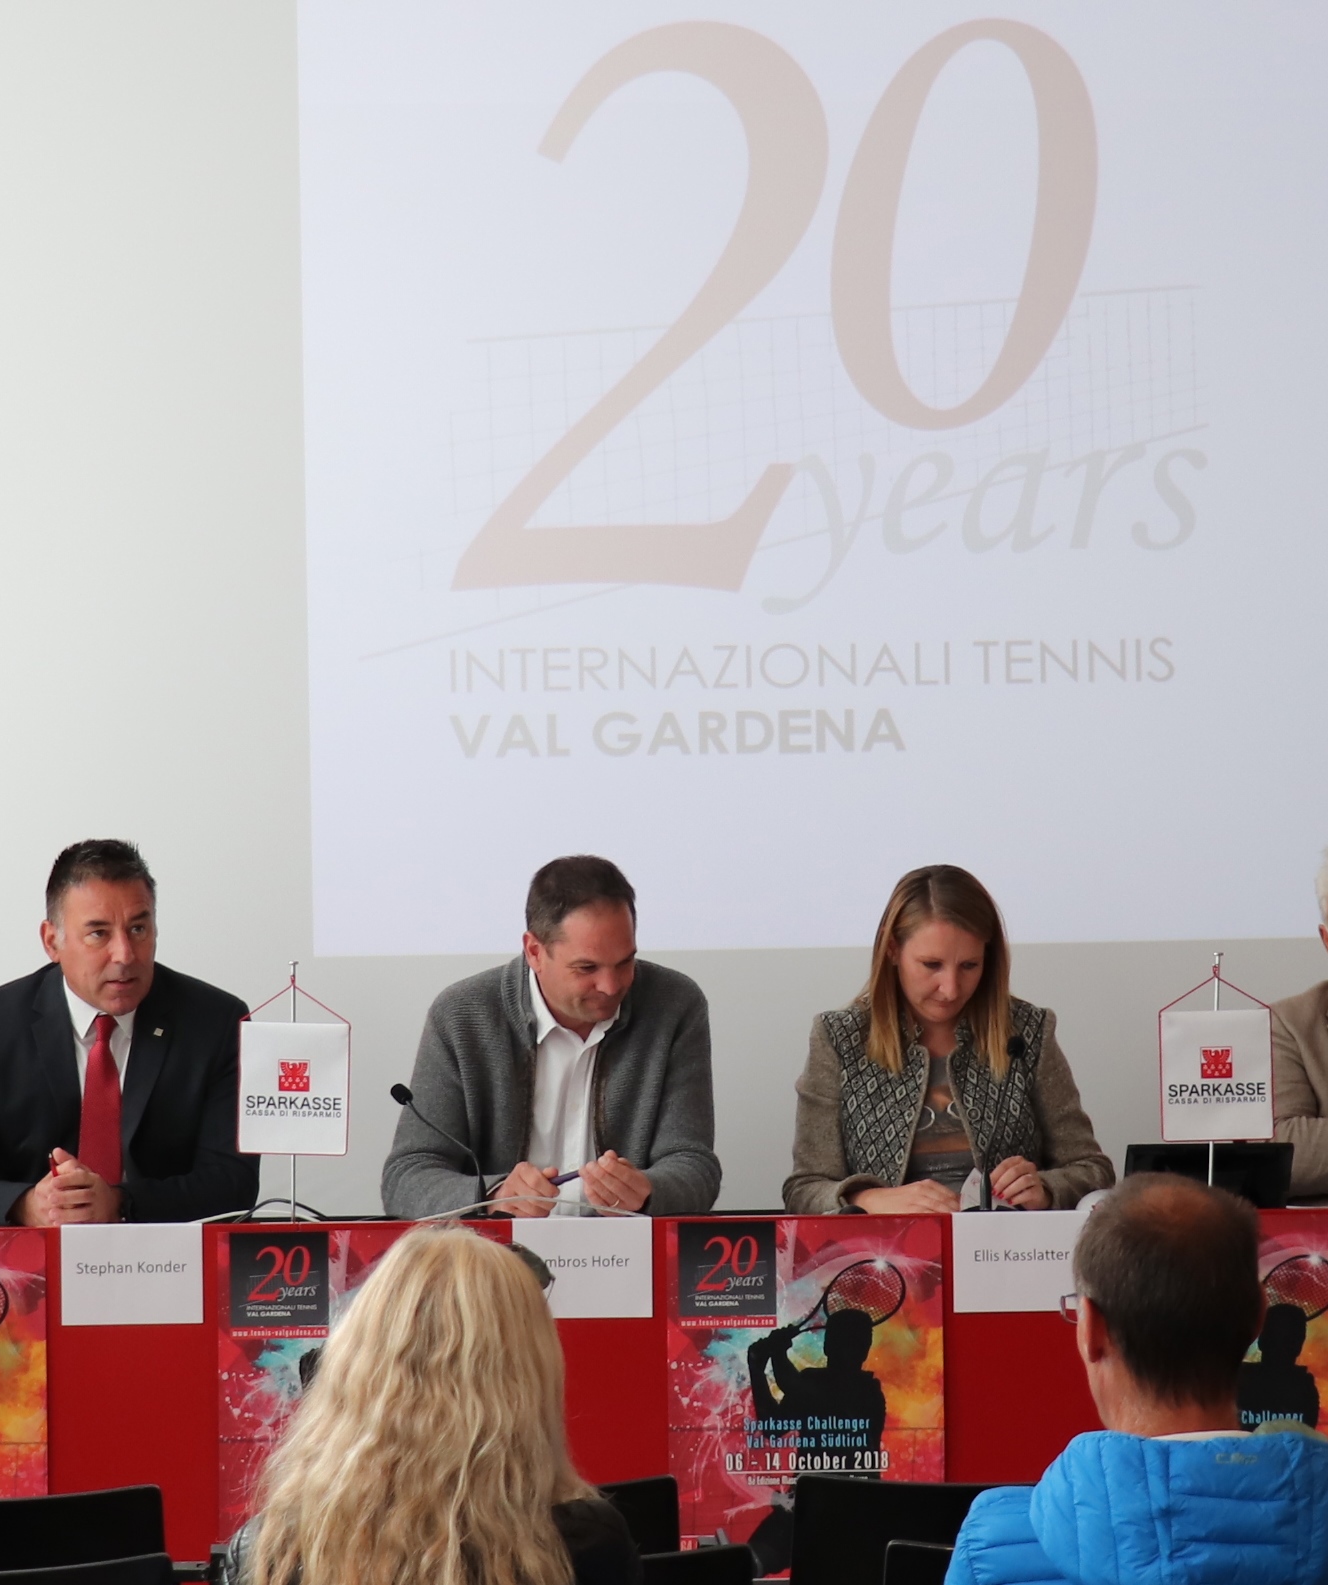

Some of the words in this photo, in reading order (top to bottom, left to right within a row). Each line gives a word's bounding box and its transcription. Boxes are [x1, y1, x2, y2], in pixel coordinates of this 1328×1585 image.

[450, 18, 1098, 592] 20
[761, 441, 1209, 615] years
[449, 641, 951, 692] INTERNAZIONALI
[974, 637, 1175, 684] TENNIS
[449, 714, 569, 758] VAL
[592, 708, 906, 757] GARDENA
[1168, 1082, 1266, 1097] SPARKASSE
[245, 1095, 342, 1110] SPARKASSE
[292, 1110, 342, 1118] RISPARMIO
[544, 1255, 587, 1268] mbros
[592, 1254, 630, 1267] Hofer
[696, 1235, 759, 1292] 20
[974, 1249, 1000, 1262] Ellis
[1004, 1248, 1070, 1261] Kasslatter
[76, 1261, 132, 1276] Stephan
[137, 1260, 187, 1273] Konder
[247, 1245, 311, 1302] 20
[725, 1275, 764, 1291] years
[277, 1285, 317, 1302] years
[744, 1417, 802, 1433] Sparkasse
[807, 1416, 870, 1432] Challenger
[746, 1435, 764, 1448] Val
[769, 1434, 816, 1448] Gardena
[821, 1433, 867, 1447] Südtirol
[725, 1453, 743, 1471] 06
[765, 1452, 780, 1470] 14
[789, 1451, 847, 1470] October
[854, 1451, 889, 1469] 2018
